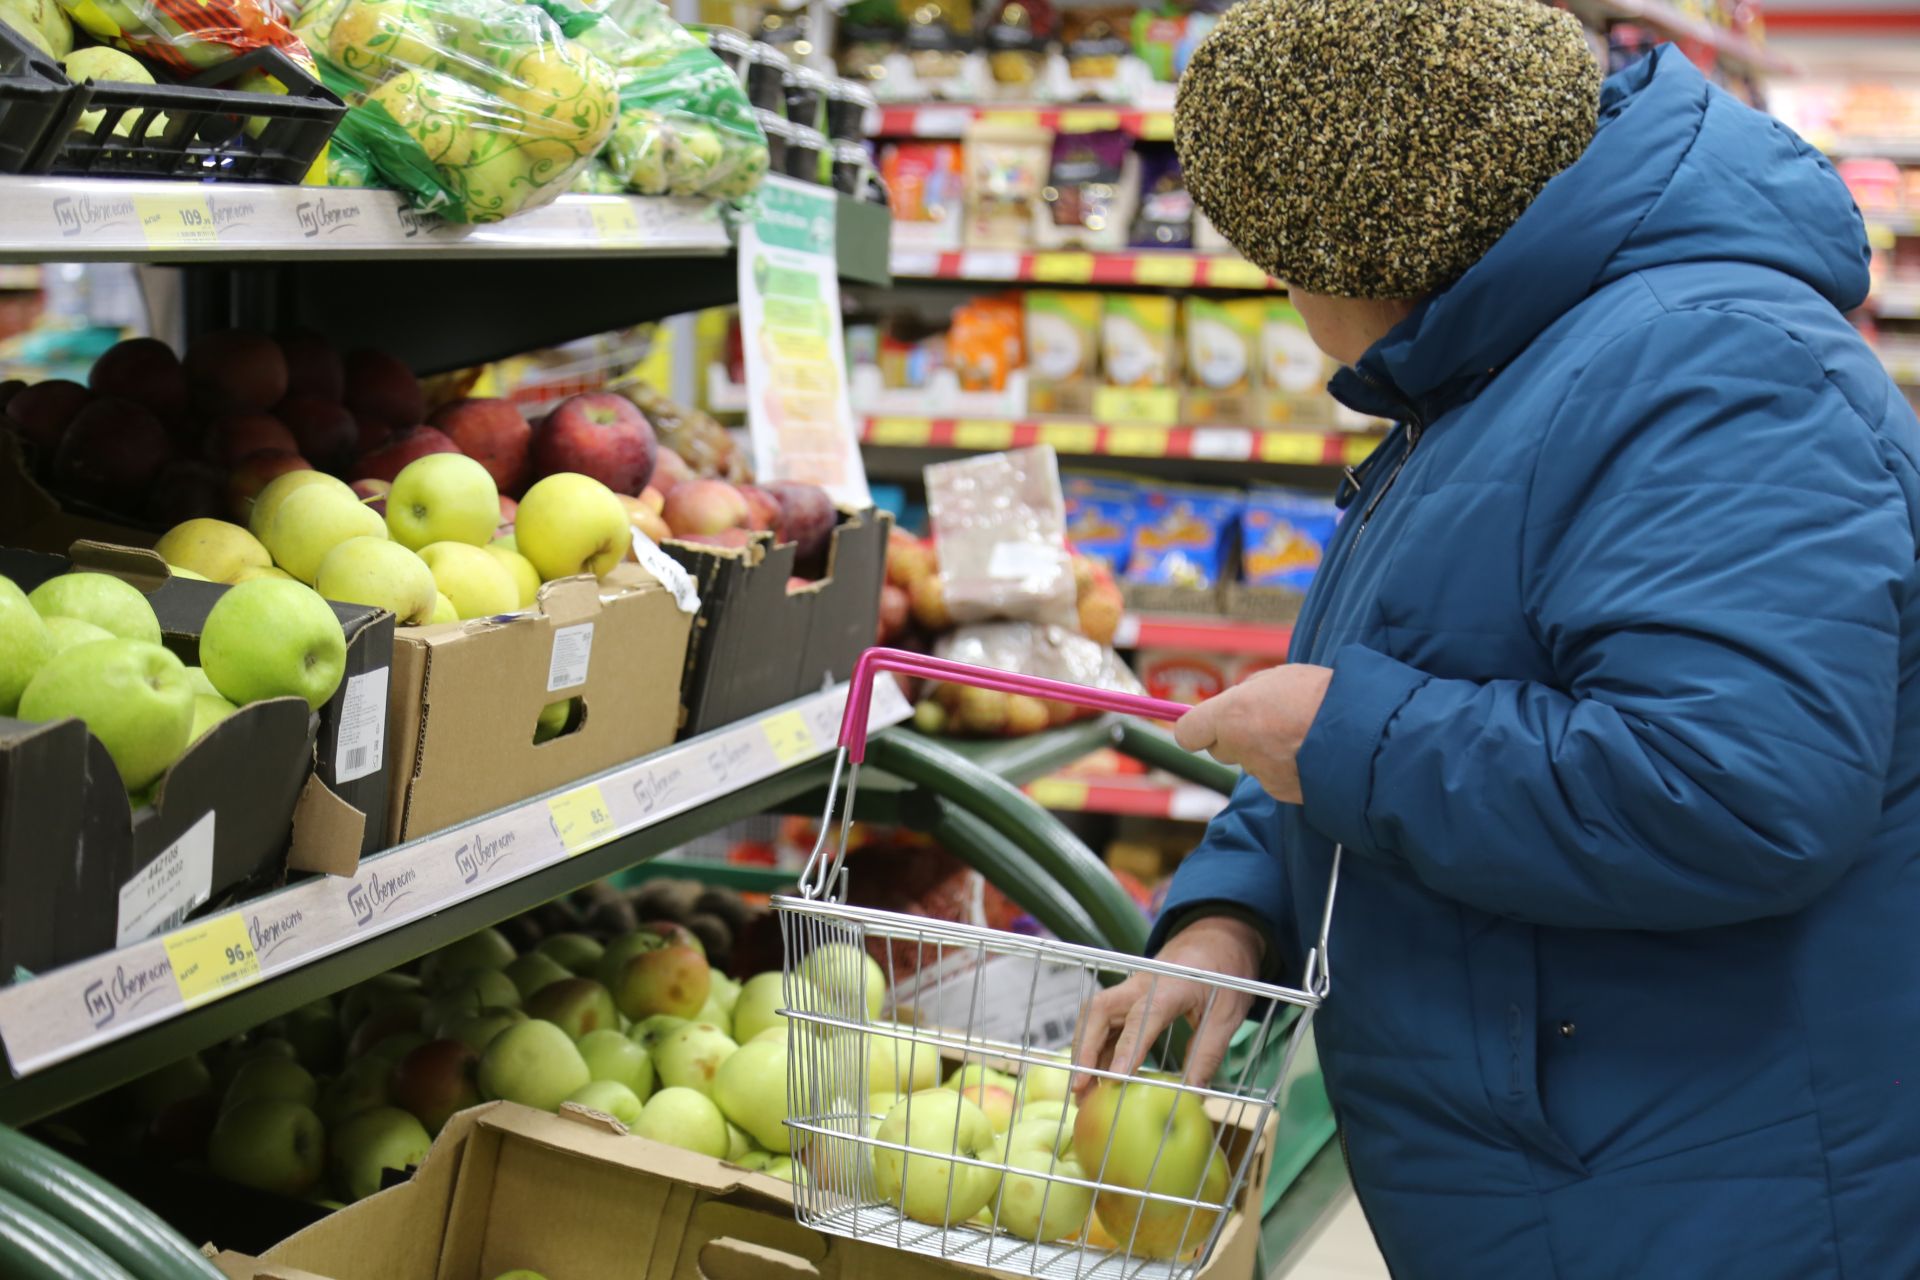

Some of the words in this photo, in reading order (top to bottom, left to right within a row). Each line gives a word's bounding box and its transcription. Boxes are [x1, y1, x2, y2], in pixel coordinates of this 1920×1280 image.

[179, 209, 202, 226] 109
[147, 860, 184, 897] 11.11.2022
[148, 845, 179, 880] 442108
[369, 868, 415, 906] Свежесть
[249, 909, 303, 952] Свежесть
[225, 943, 245, 965] 96
